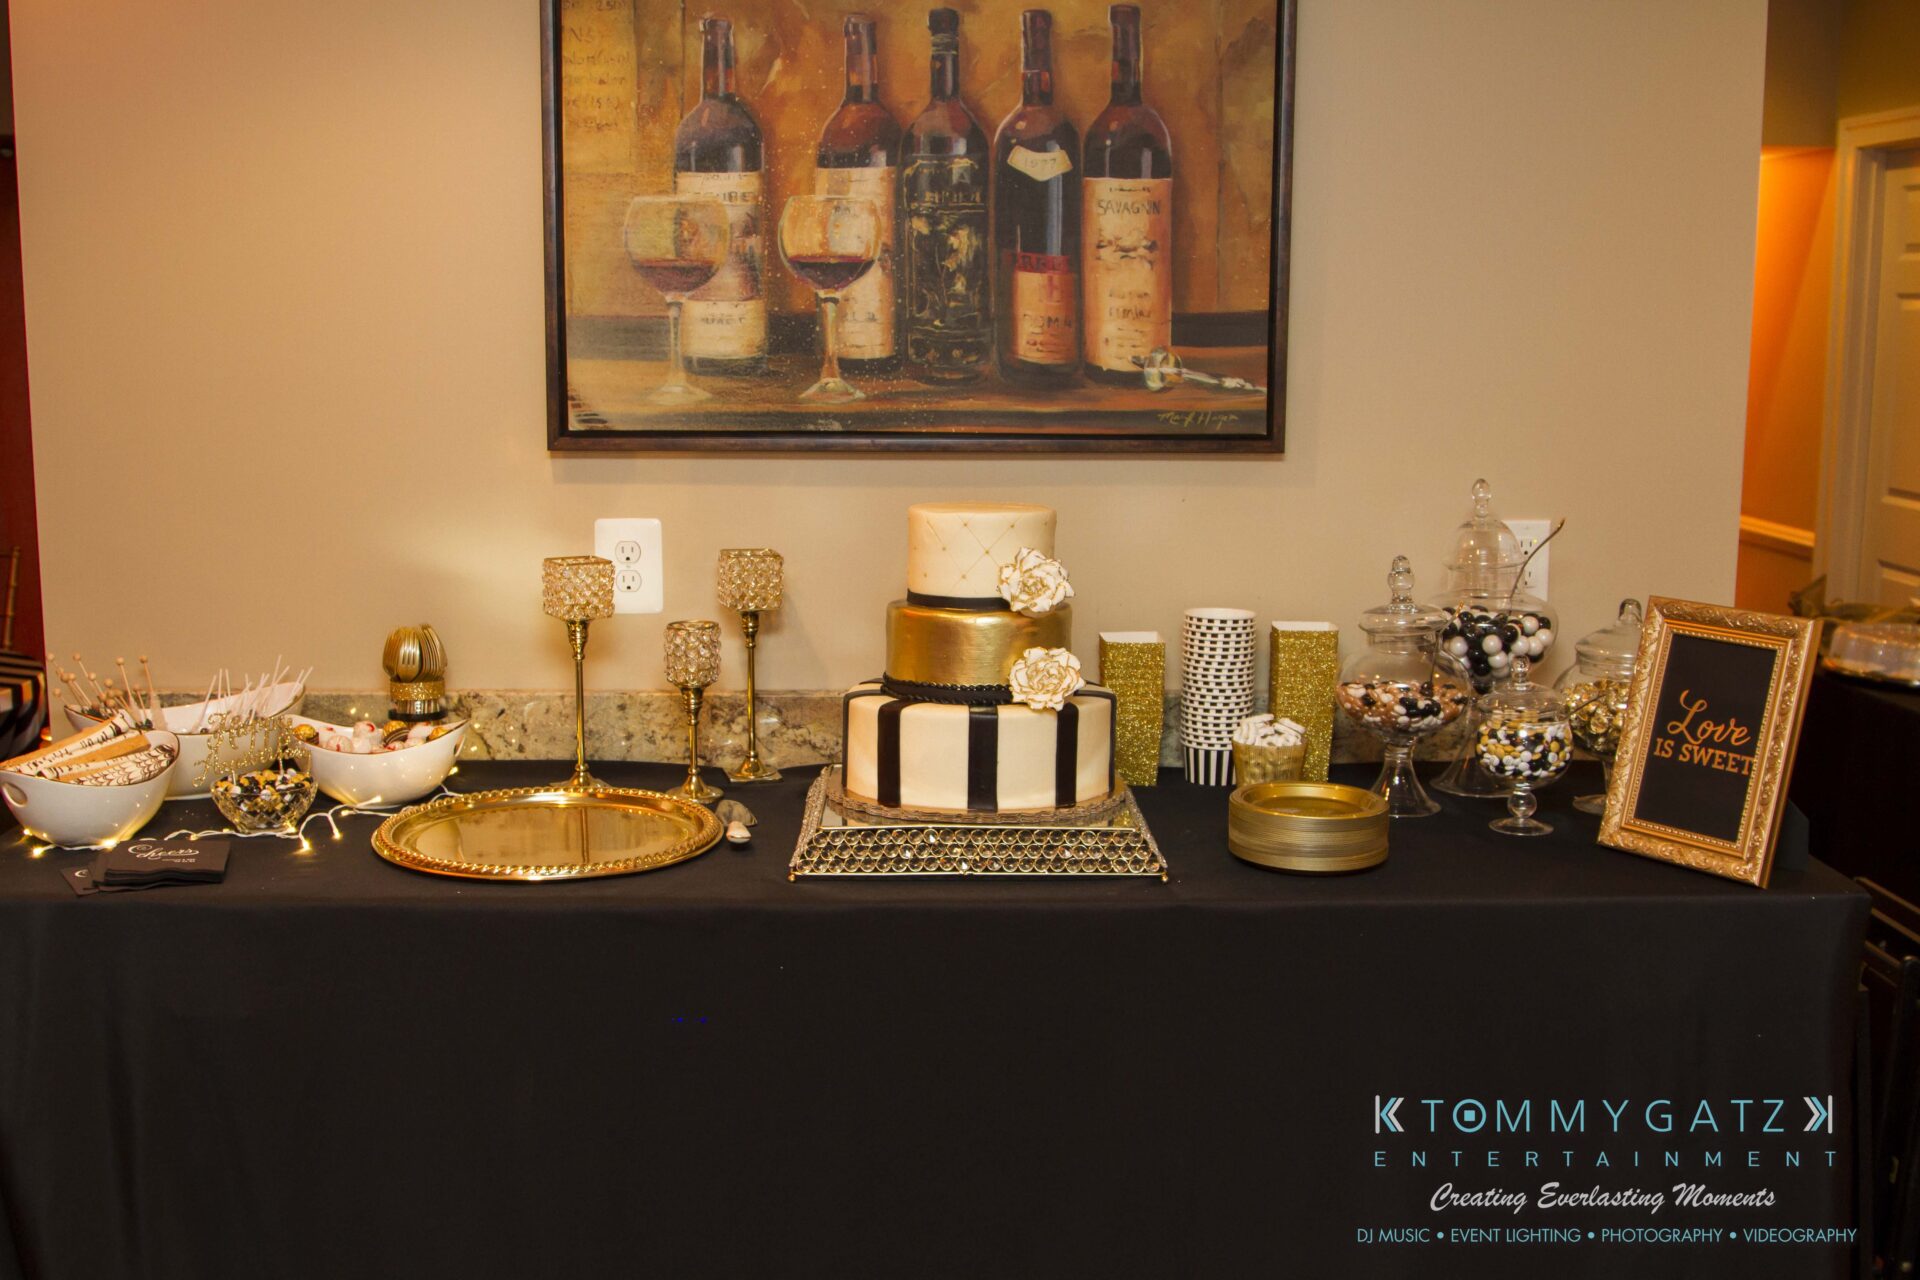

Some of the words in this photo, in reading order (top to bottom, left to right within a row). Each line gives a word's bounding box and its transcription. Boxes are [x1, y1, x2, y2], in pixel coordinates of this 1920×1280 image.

[1667, 690, 1751, 745] Love
[1654, 737, 1675, 758] IS
[1679, 743, 1755, 775] SWEET
[128, 844, 200, 860] Cheers
